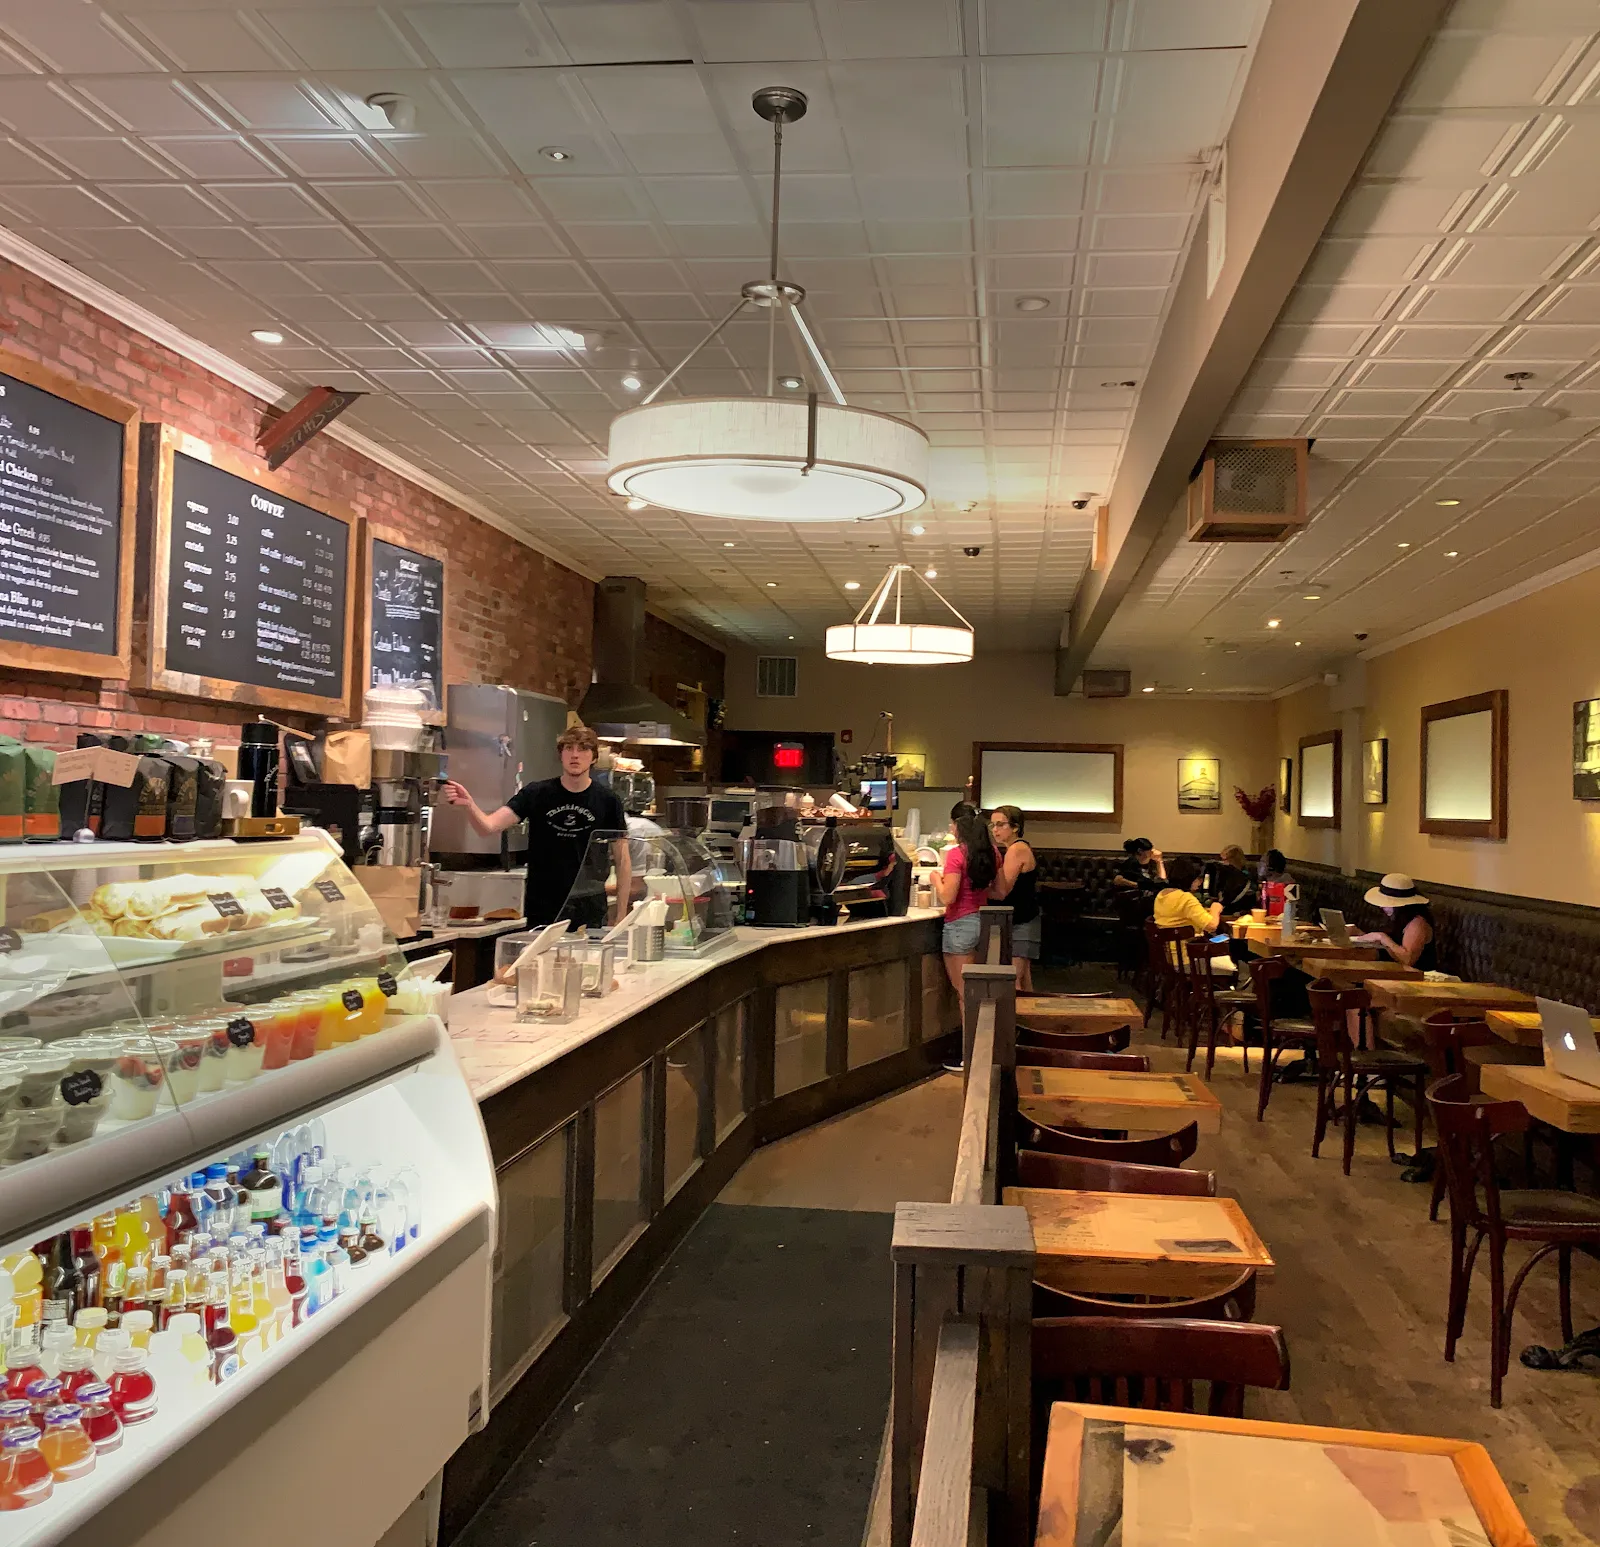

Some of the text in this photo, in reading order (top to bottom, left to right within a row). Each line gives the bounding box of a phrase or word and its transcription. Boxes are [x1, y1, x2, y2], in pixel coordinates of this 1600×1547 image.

[5, 462, 39, 483] Chicken
[250, 493, 285, 519] COFFEE
[13, 522, 37, 540] Greek
